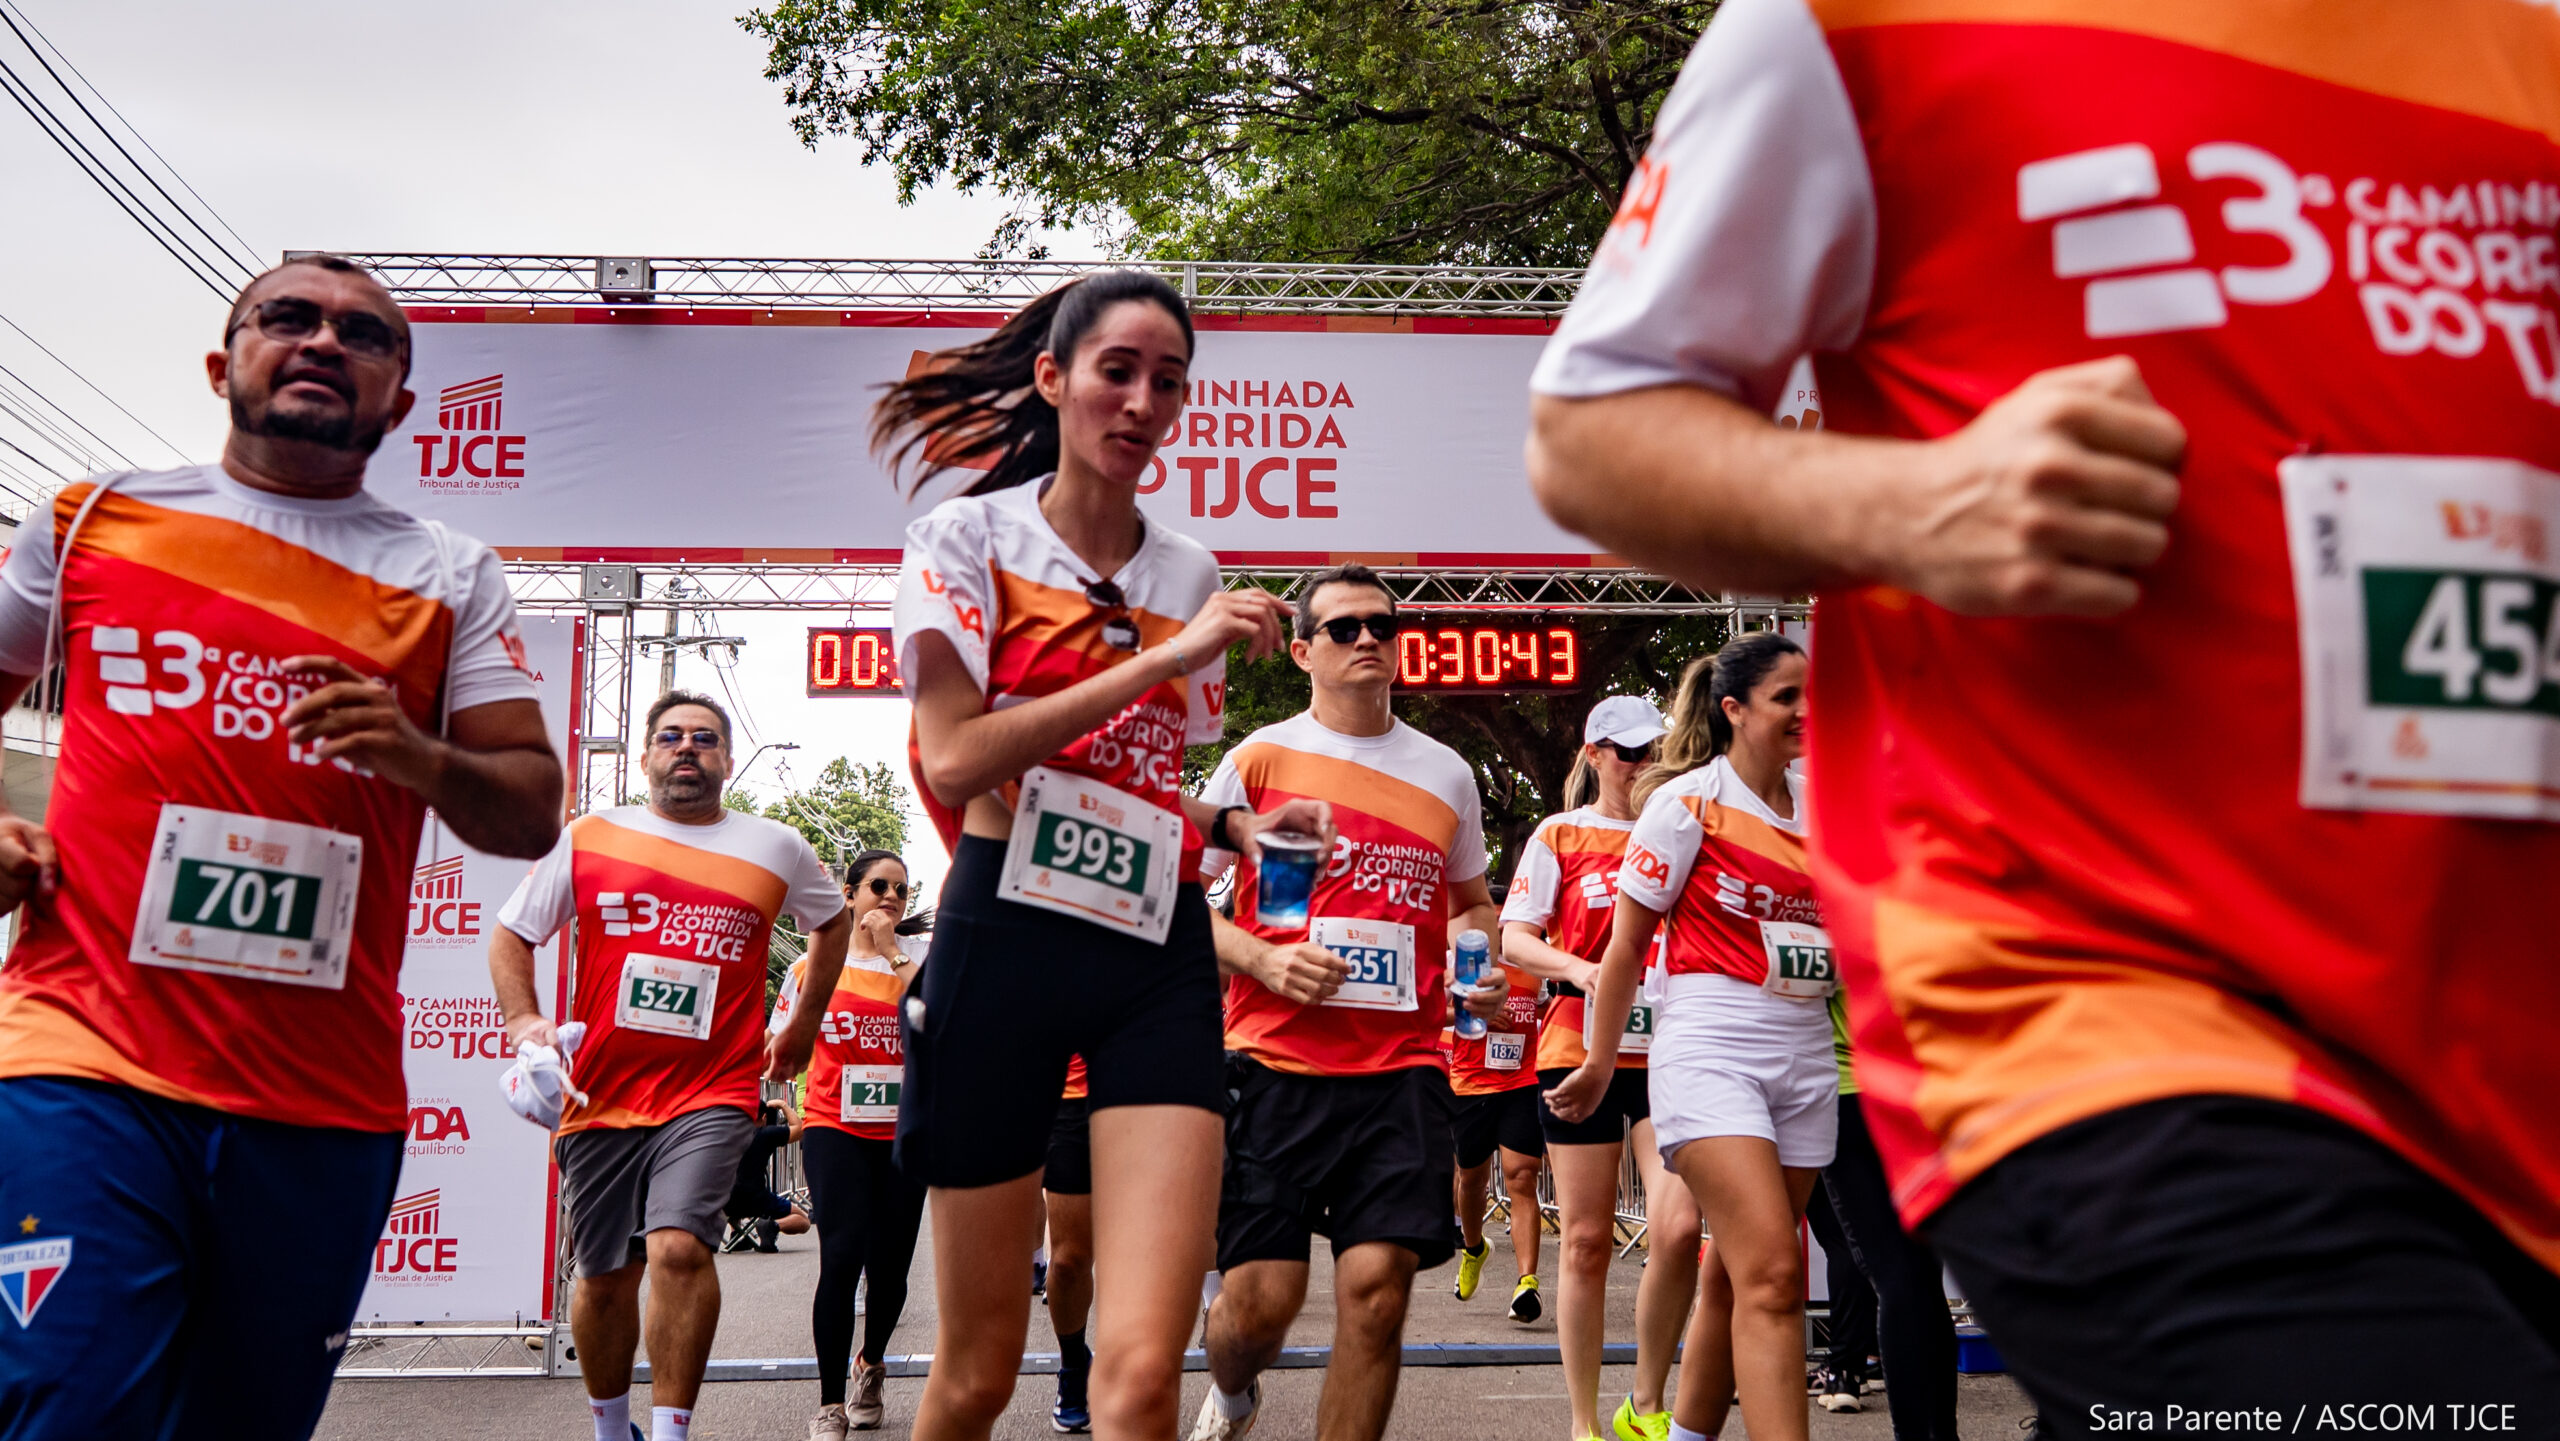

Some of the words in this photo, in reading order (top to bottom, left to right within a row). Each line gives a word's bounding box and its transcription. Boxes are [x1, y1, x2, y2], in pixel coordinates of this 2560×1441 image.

[2358, 281, 2487, 359] DO
[1186, 379, 1354, 408] INHADA
[413, 435, 526, 477] TJCE
[418, 479, 463, 489] Tribunal
[466, 479, 480, 489] de
[483, 479, 520, 491] Justiça
[1177, 456, 1339, 519] TJCE
[213, 703, 274, 741] DO
[1051, 819, 1136, 885] 993
[194, 864, 298, 932] 701
[1352, 872, 1381, 893] DO
[1385, 877, 1435, 912] TJCE
[662, 913, 753, 939] /CORRIDA
[672, 902, 760, 926] CAMINHADA
[435, 936, 446, 944] de
[448, 936, 477, 946] Justiça
[659, 928, 692, 947] DO
[694, 932, 746, 962] TJCE
[1786, 946, 1829, 978] 175
[638, 980, 690, 1012] 527
[410, 1030, 444, 1049] DO
[448, 1031, 517, 1059] TJCE
[860, 1036, 880, 1049] DO
[1493, 1044, 1520, 1060] 1879
[864, 1083, 886, 1105] 21
[375, 1238, 458, 1273] TJCE
[424, 1275, 453, 1283] Justiça
